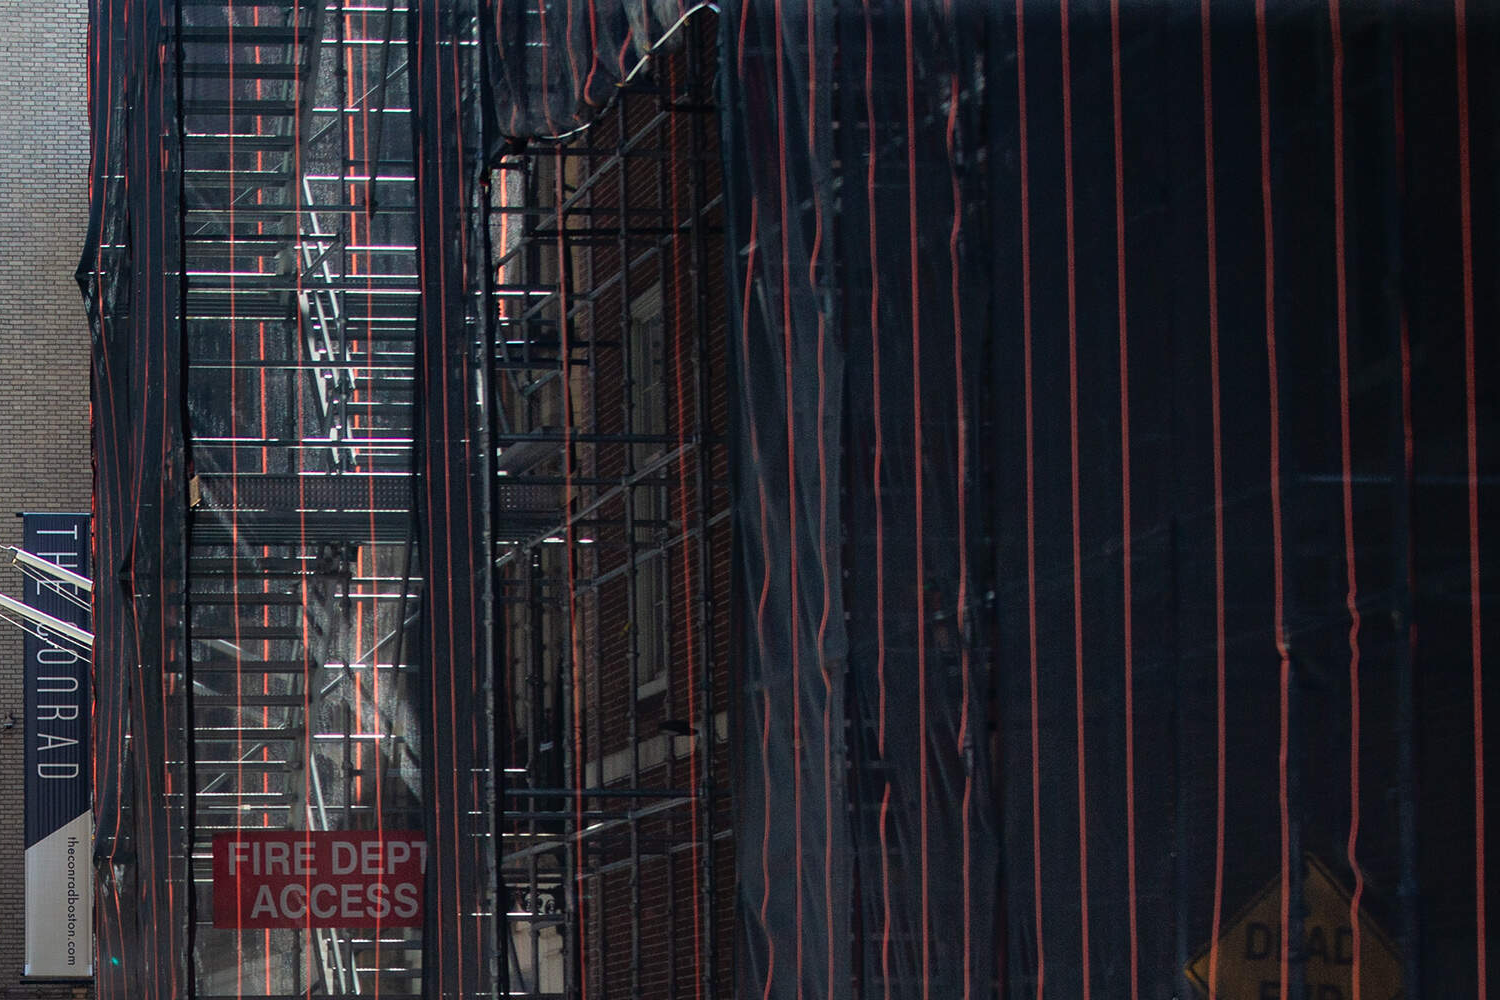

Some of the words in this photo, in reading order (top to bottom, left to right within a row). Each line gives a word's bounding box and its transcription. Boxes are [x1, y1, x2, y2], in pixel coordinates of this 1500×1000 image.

[36, 524, 79, 596] THE
[227, 841, 318, 876] FIRE
[67, 836, 79, 966] theconradboston.com
[250, 882, 419, 919] ACCESS
